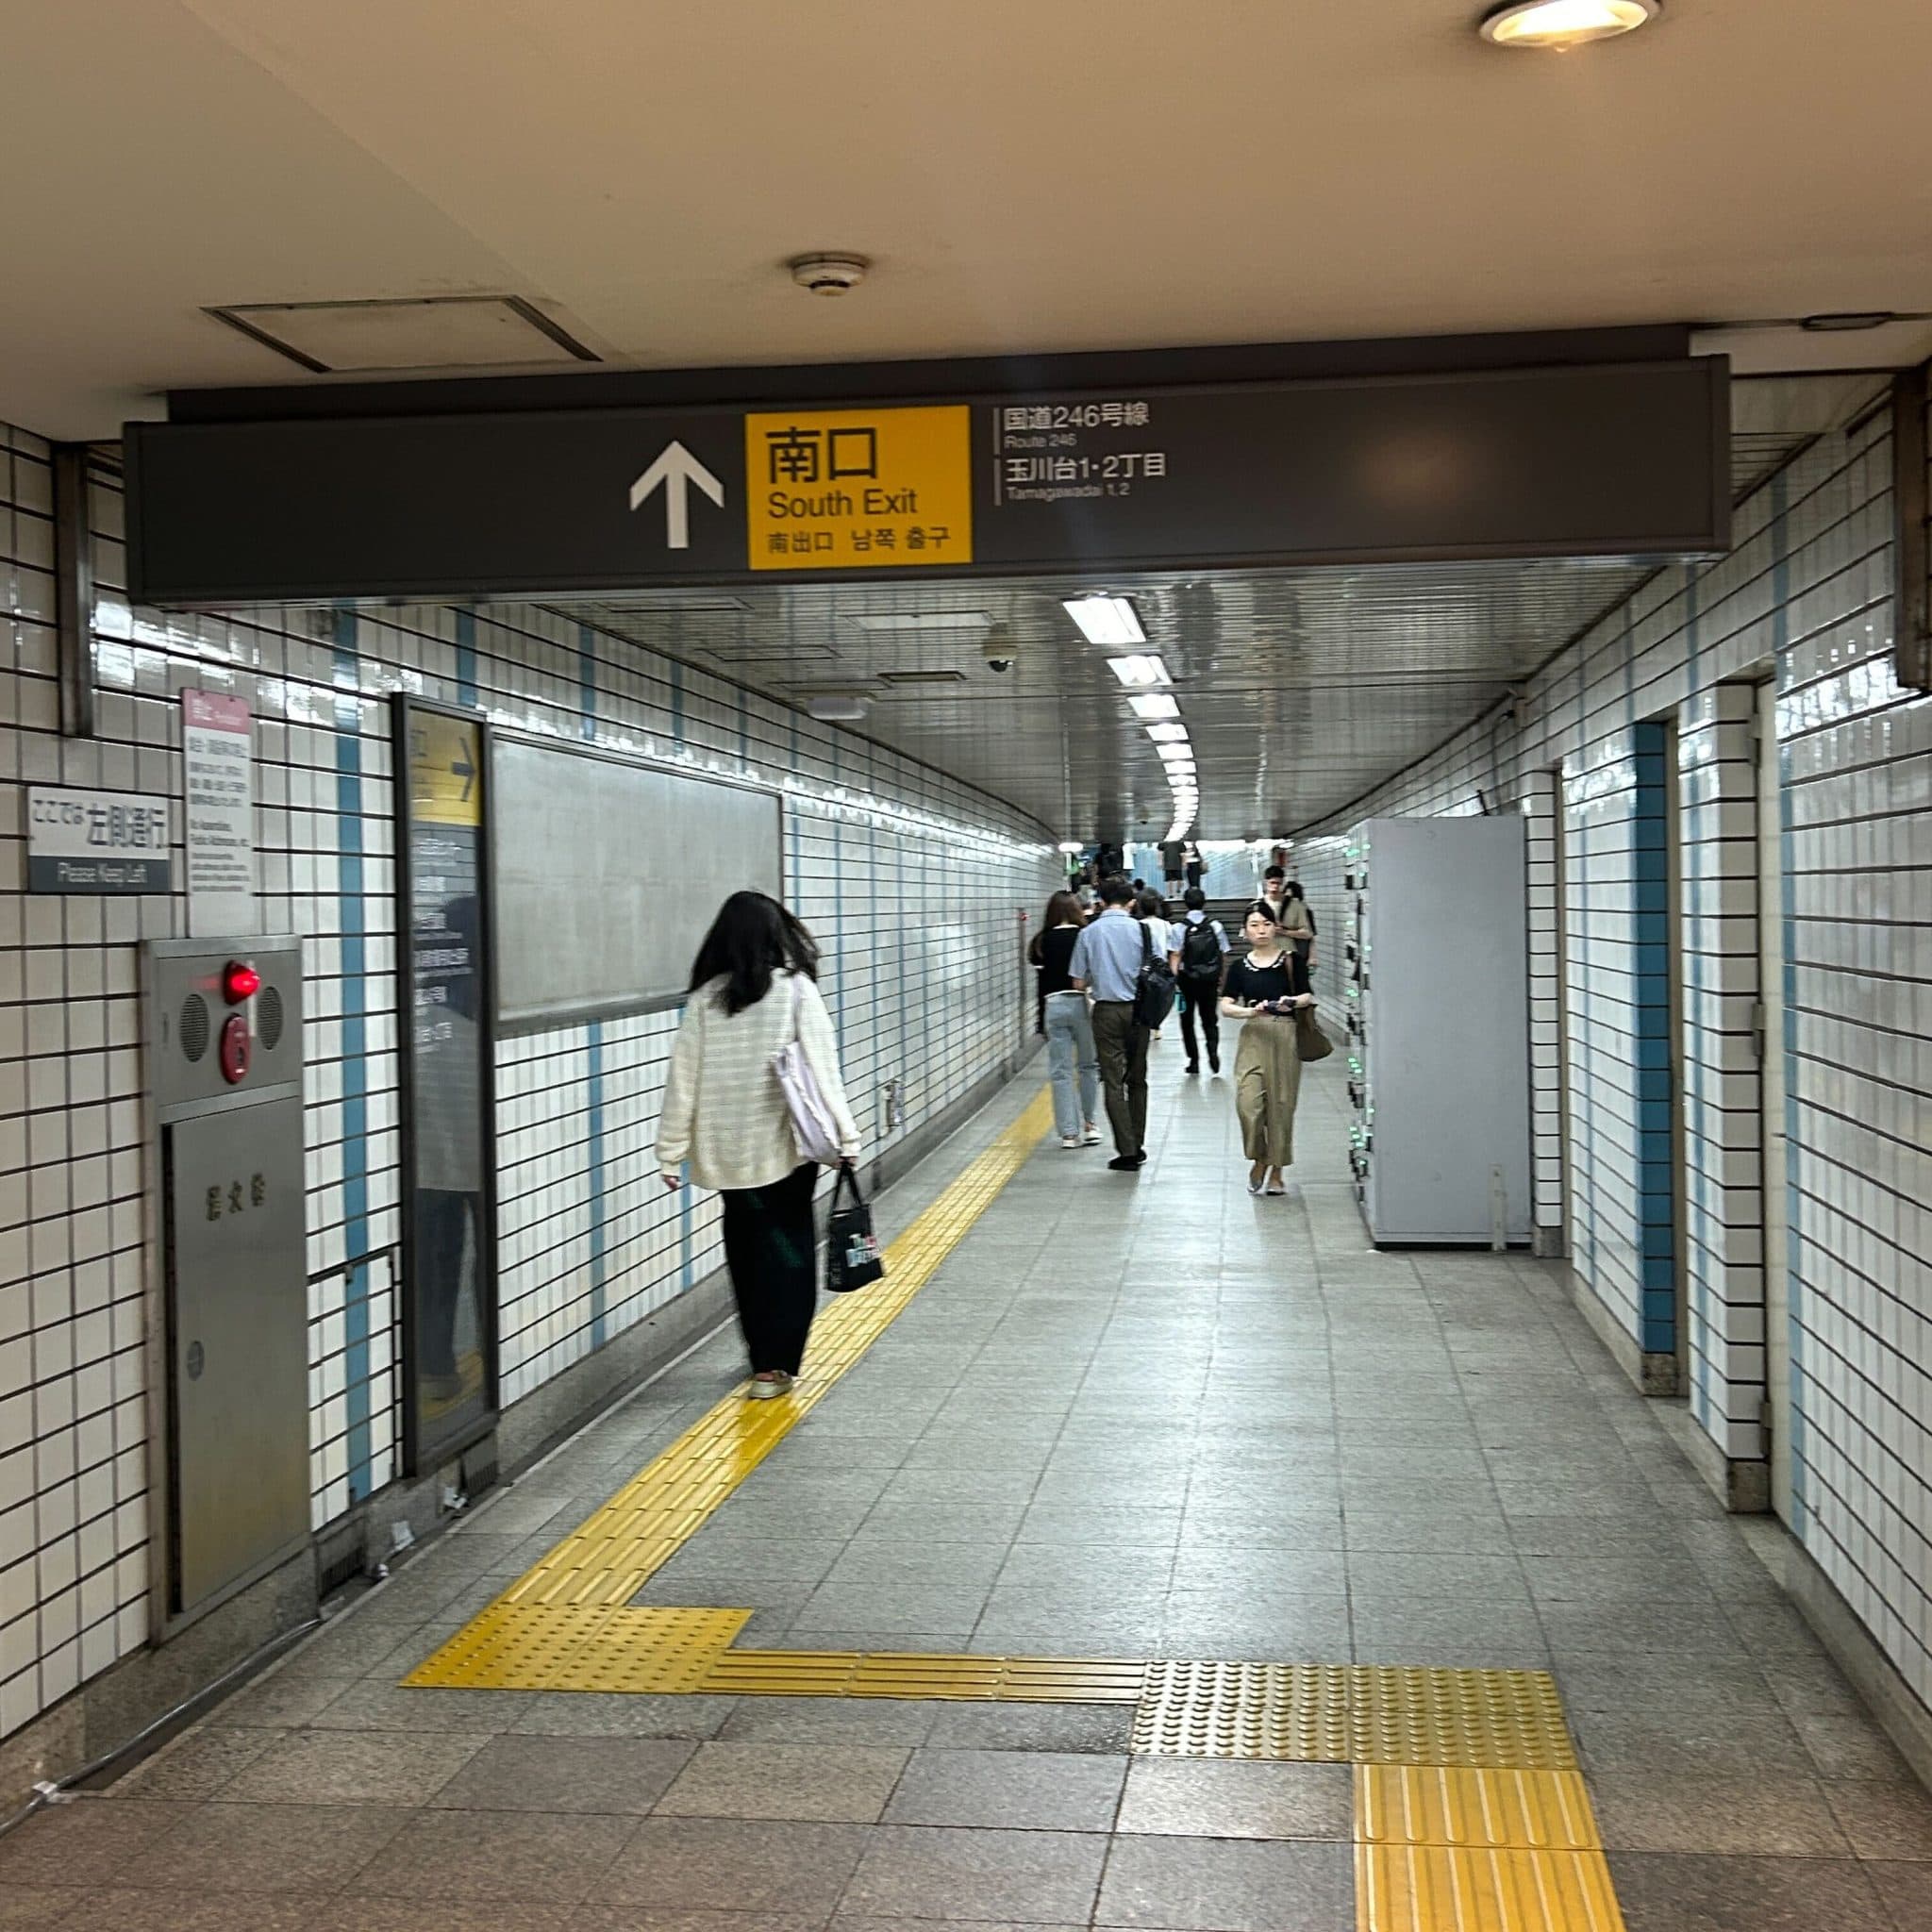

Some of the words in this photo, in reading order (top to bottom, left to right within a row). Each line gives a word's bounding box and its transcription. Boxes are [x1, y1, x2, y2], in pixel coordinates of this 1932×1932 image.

[1004, 401, 1150, 431] 国道246号線
[765, 426, 877, 484] 南口
[1004, 435, 1047, 448] Route
[768, 490, 853, 518] South
[864, 488, 918, 515] Exit
[768, 531, 833, 554] 南出口
[851, 527, 895, 551] 남쪽
[906, 525, 951, 550] 출구
